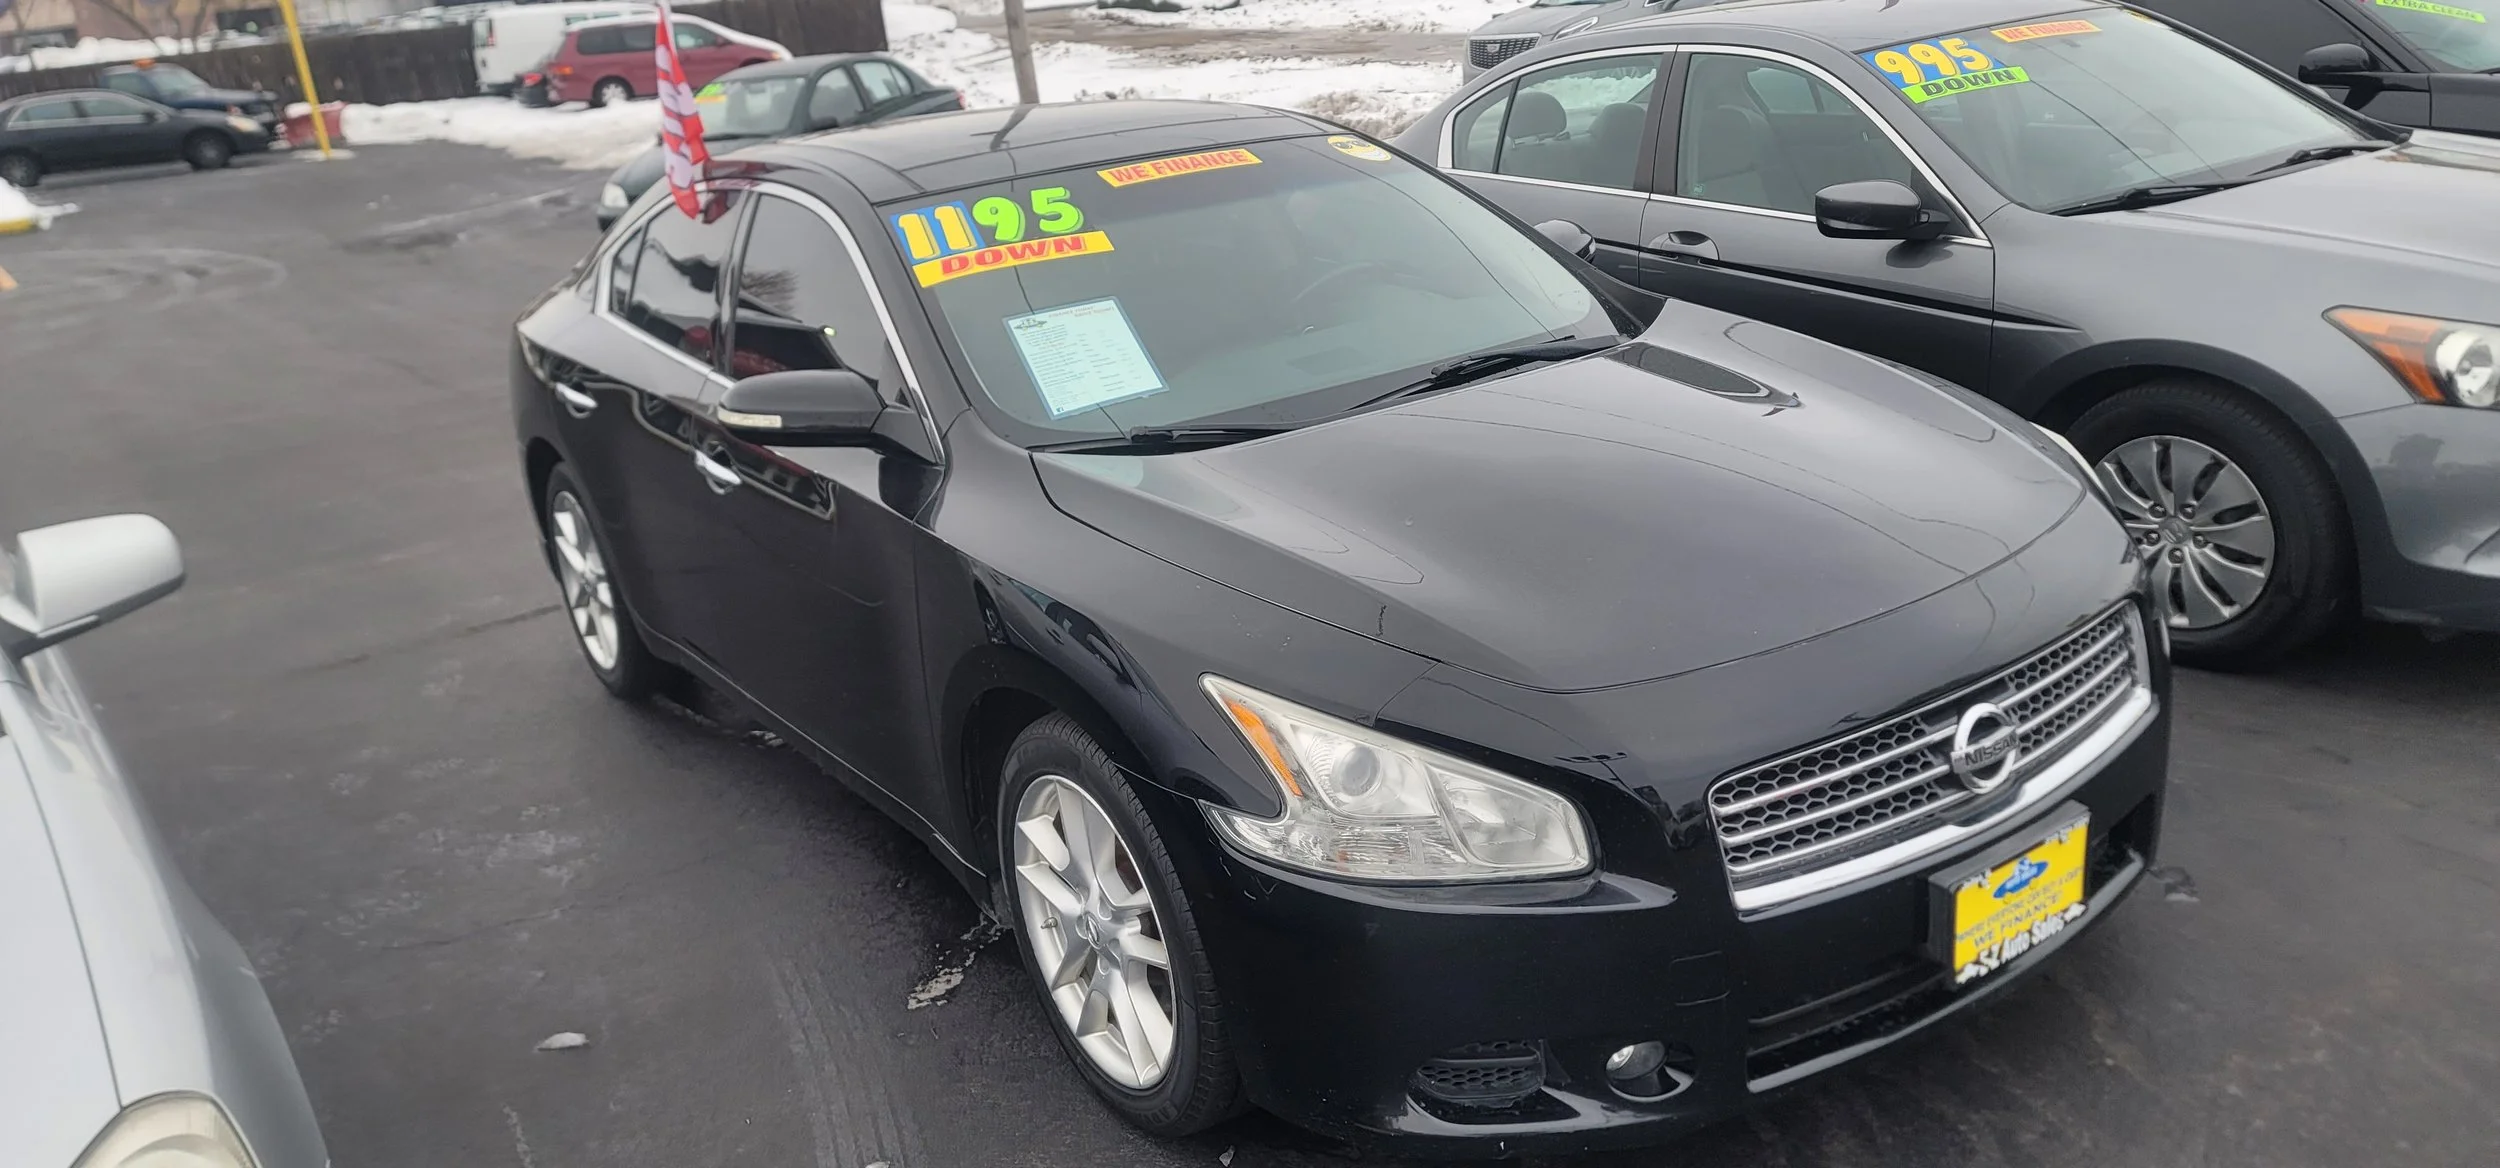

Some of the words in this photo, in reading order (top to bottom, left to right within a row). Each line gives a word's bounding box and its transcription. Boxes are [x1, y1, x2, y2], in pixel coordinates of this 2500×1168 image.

[1999, 28, 2026, 40] WE
[1874, 38, 1994, 84] 995
[1920, 69, 2019, 97] DOWN
[1108, 165, 1149, 183] WE
[1151, 150, 1248, 175] FINANCE
[898, 186, 1084, 260] 1195
[941, 235, 1087, 276] DOWN
[1964, 733, 2018, 766] NISSAN
